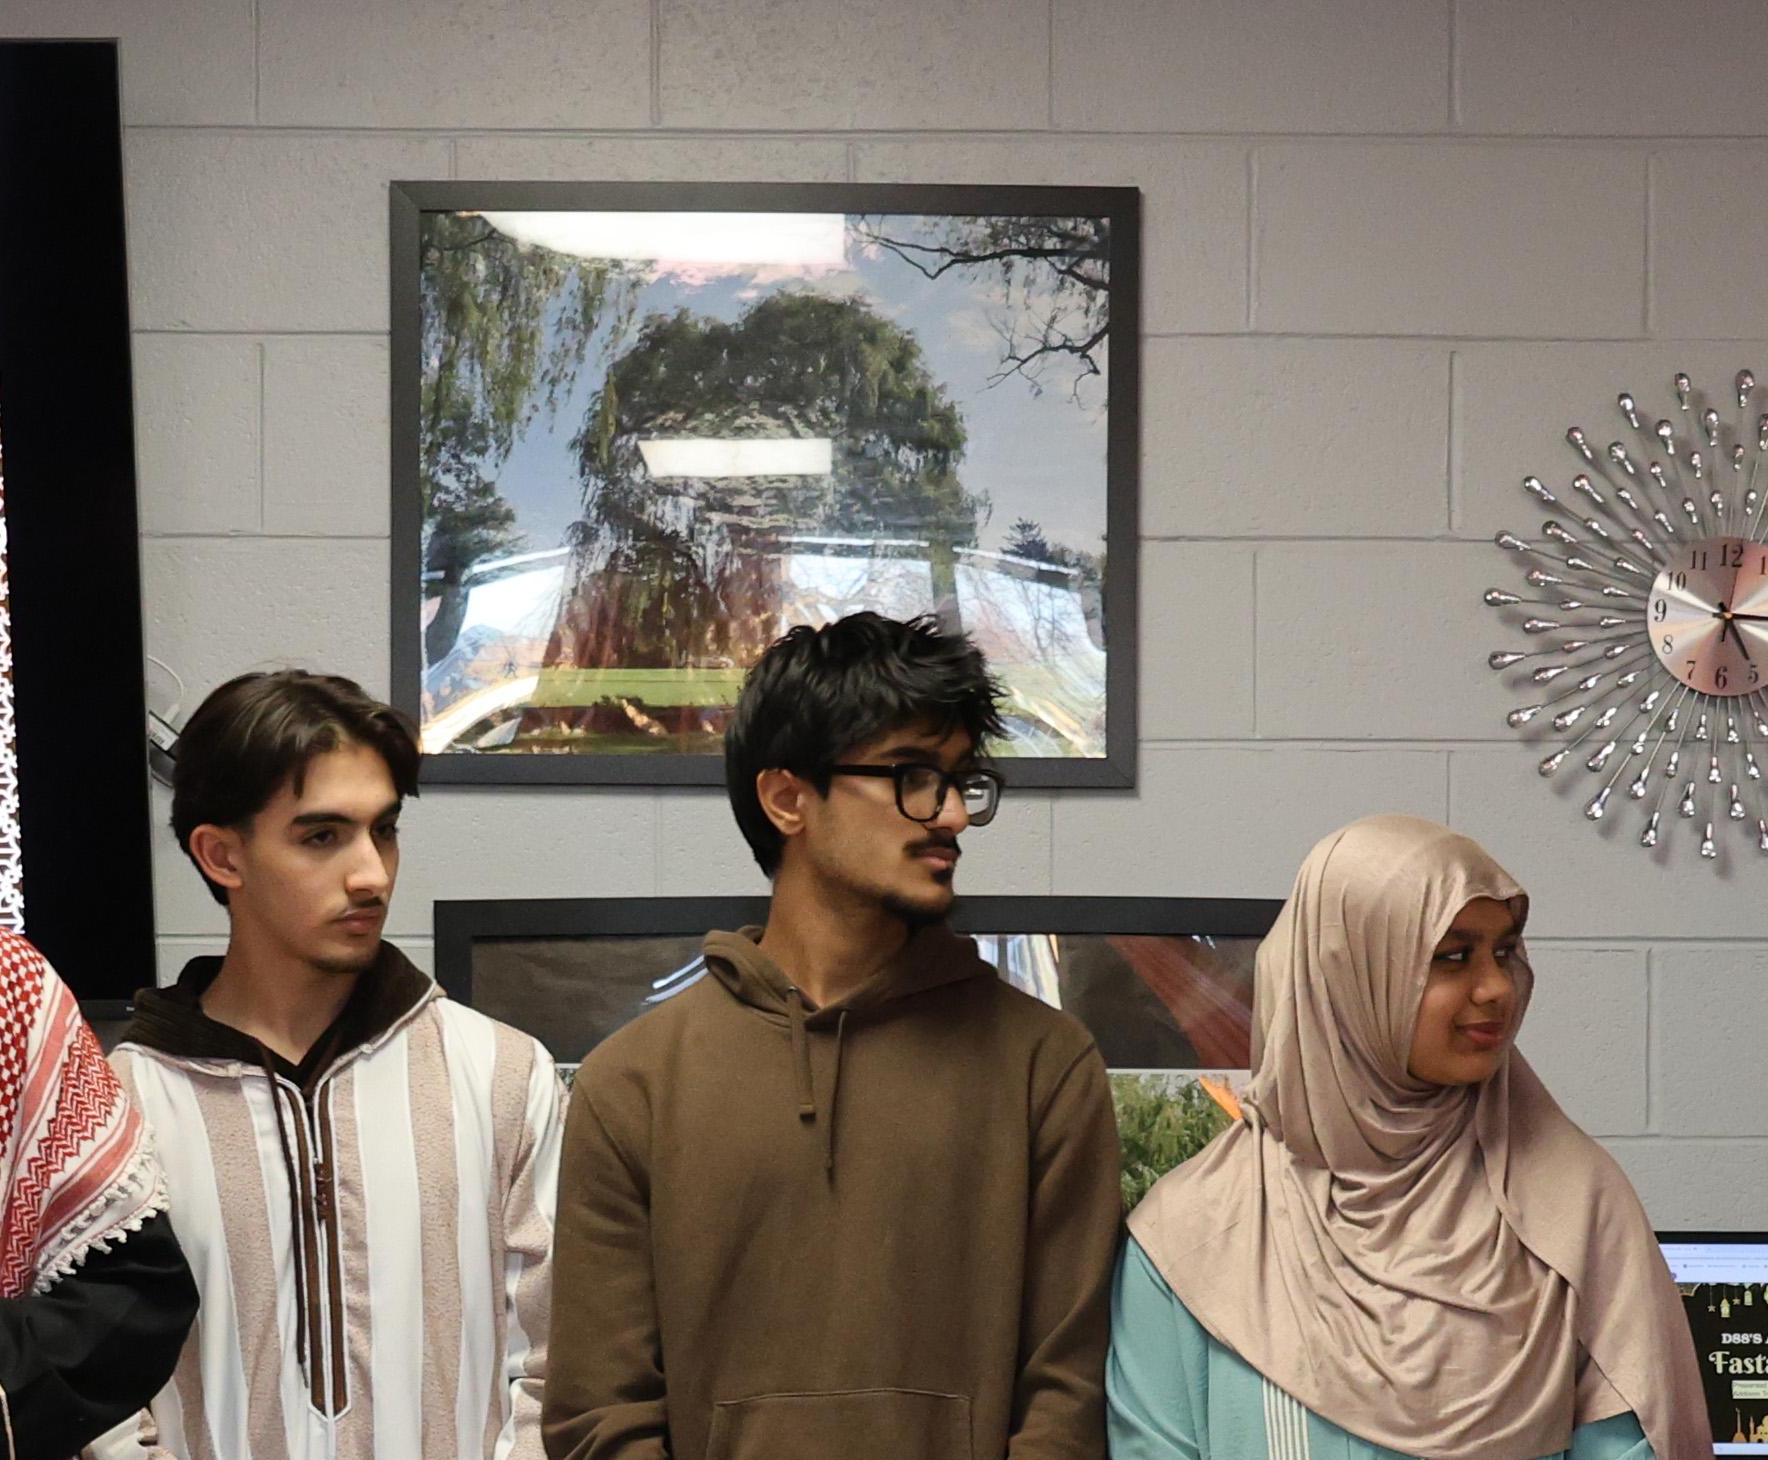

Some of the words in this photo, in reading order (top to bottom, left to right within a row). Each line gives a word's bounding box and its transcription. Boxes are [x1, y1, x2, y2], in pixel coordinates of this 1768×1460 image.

[1690, 551, 1707, 571] 11
[1720, 544, 1743, 567] 12
[1760, 556, 1767, 575] 1
[1667, 571, 1686, 590] 10
[1654, 599, 1667, 622] 9
[1663, 635, 1673, 654] 8
[1686, 661, 1696, 681] 7
[1715, 666, 1727, 689] 6
[1748, 665, 1759, 684] 5
